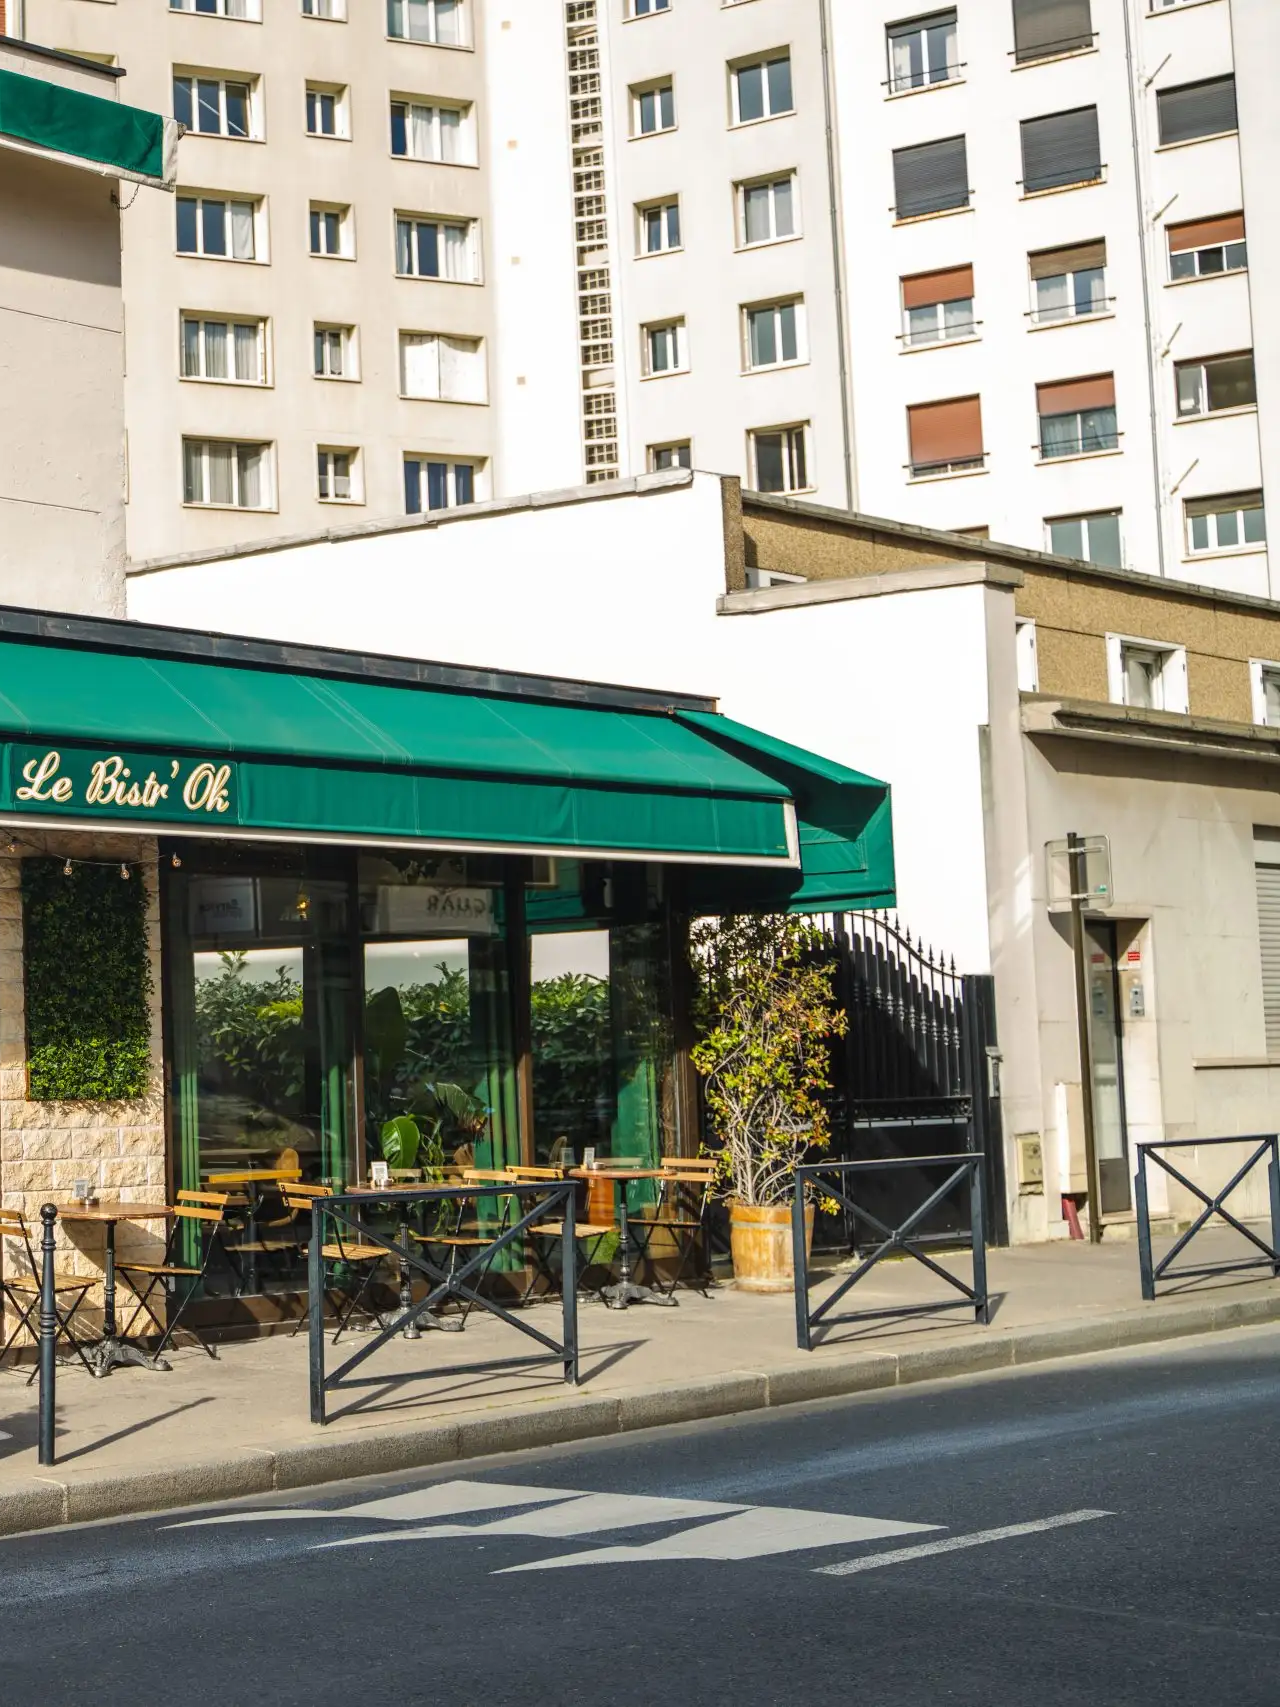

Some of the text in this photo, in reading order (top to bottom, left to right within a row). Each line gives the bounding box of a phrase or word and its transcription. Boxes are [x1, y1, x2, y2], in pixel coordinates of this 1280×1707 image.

[17, 751, 231, 812] Le Bistr' Ok
